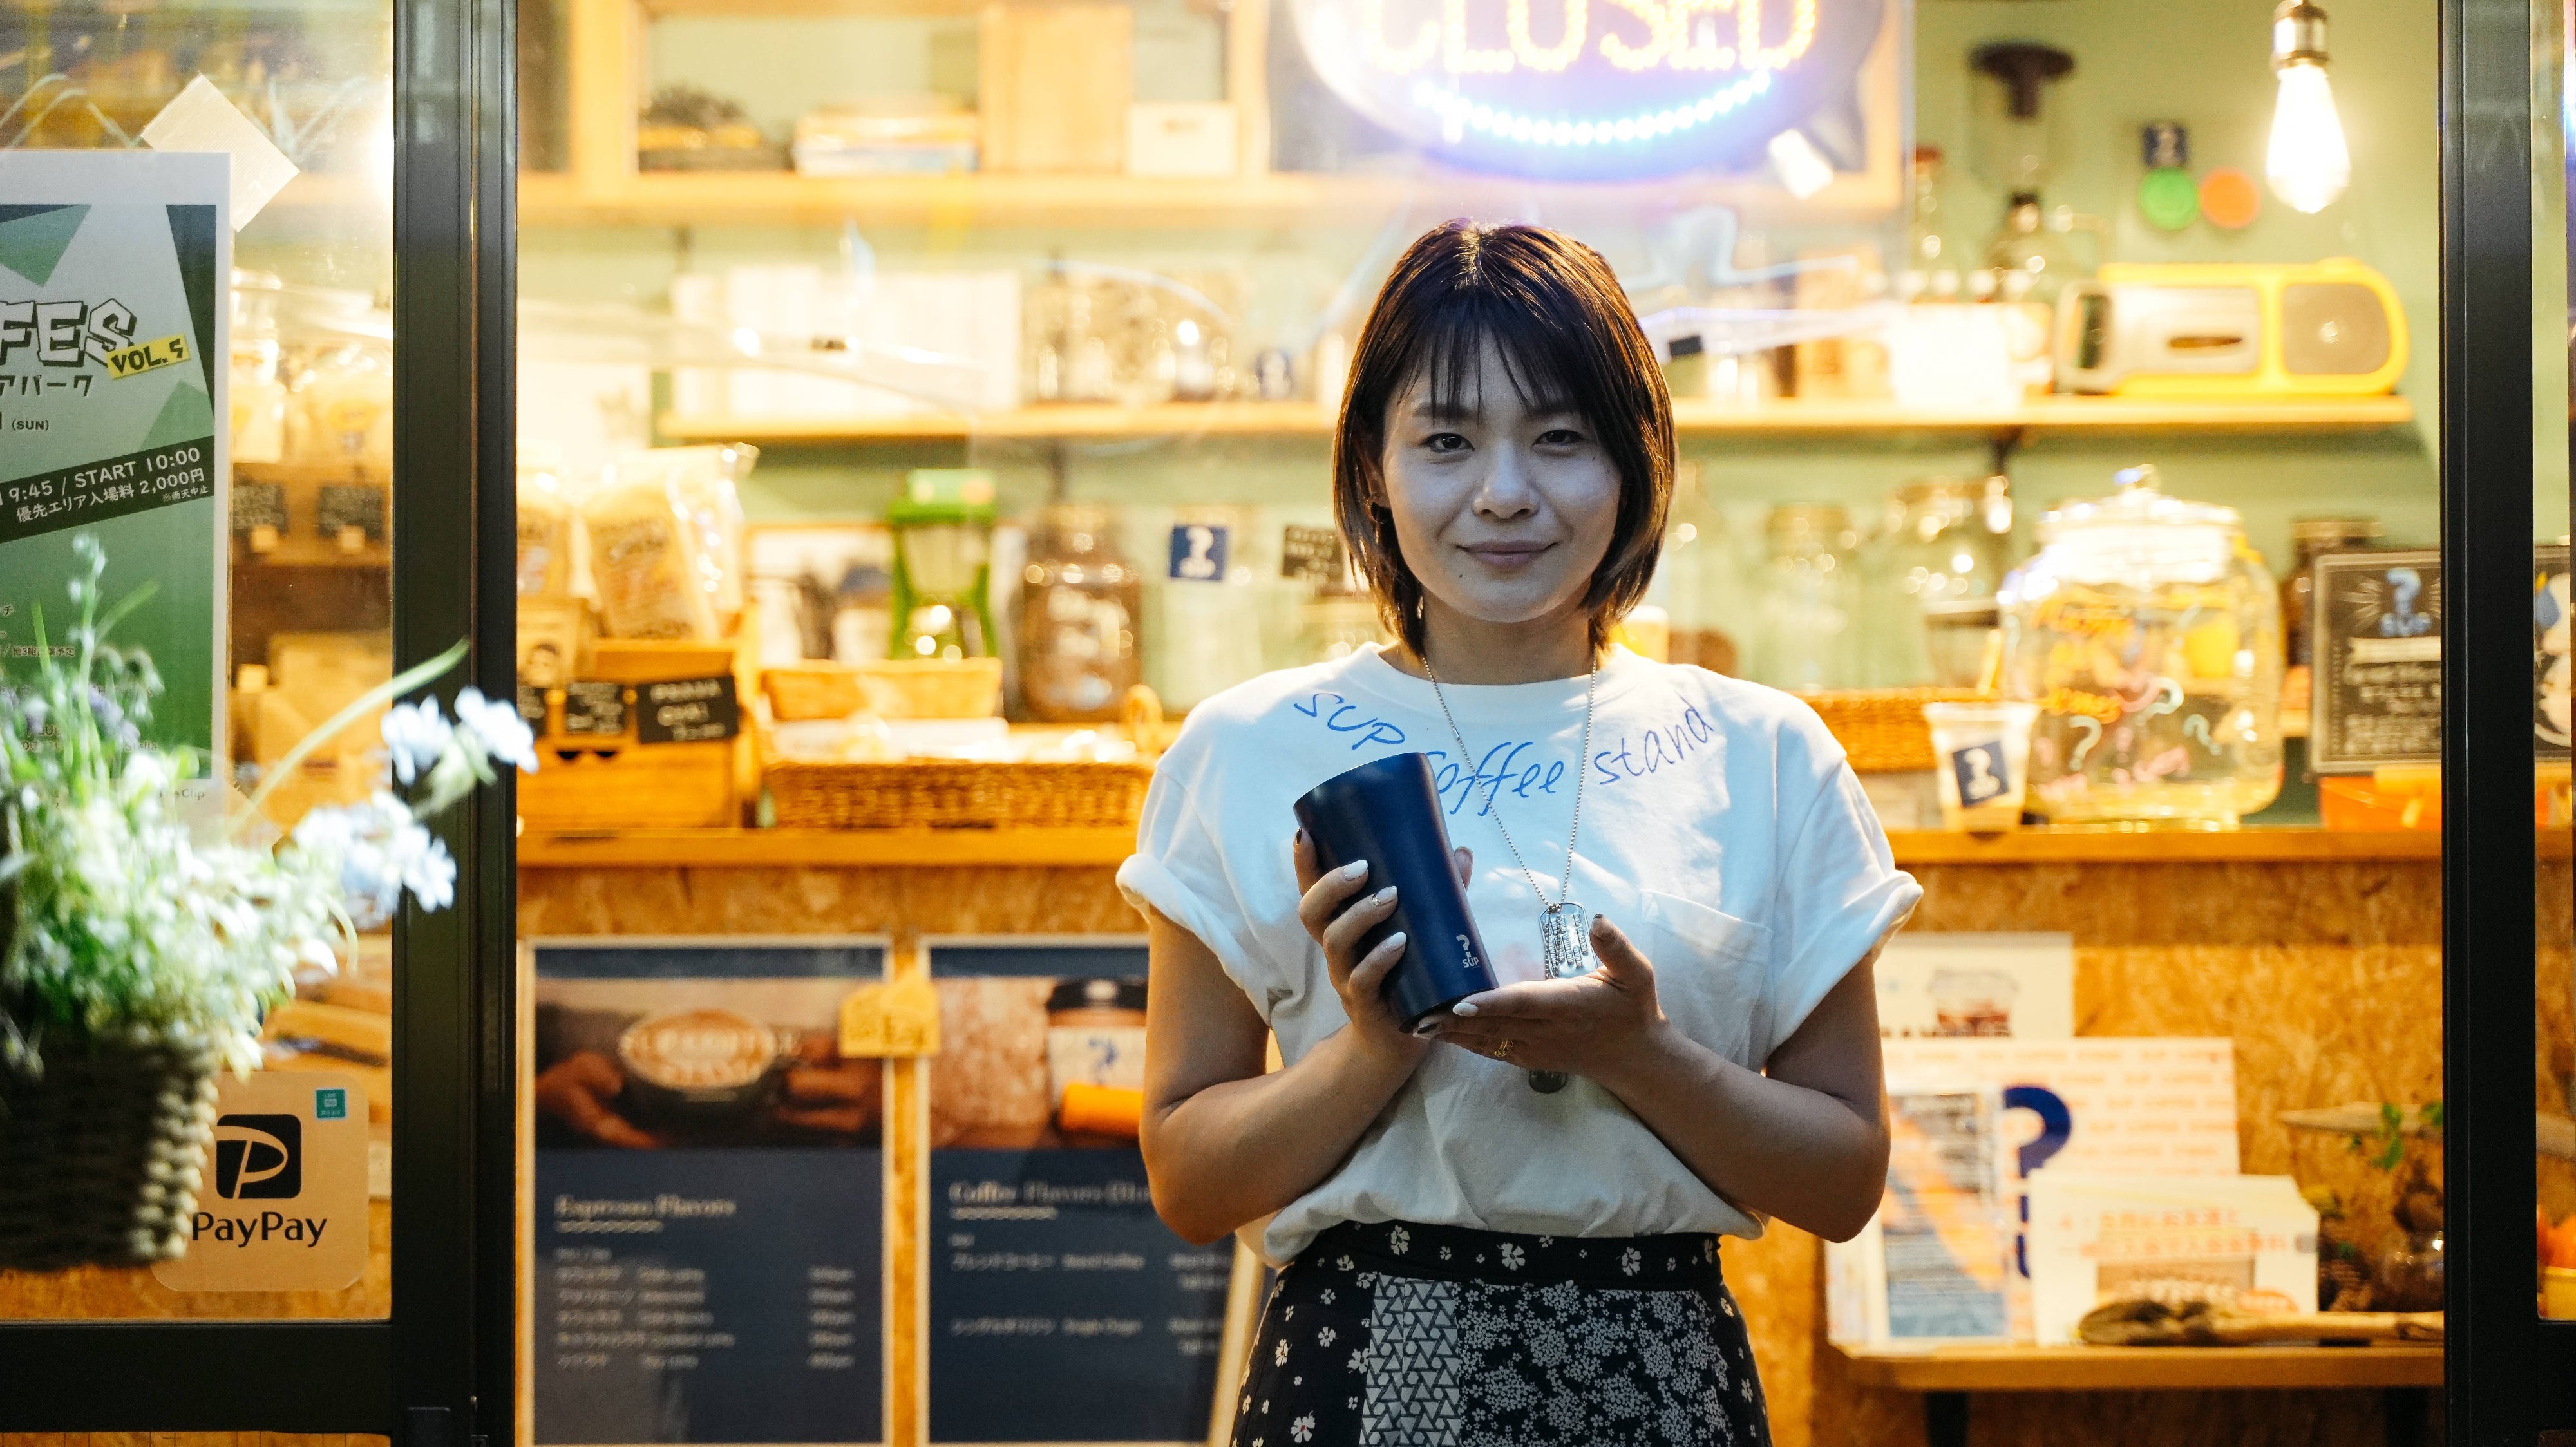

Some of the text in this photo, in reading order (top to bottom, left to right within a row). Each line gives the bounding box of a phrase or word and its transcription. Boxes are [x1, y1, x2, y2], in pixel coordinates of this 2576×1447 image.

[12, 419, 49, 431] (SUN)
[8, 480, 53, 502] 9:45
[73, 460, 137, 488] START
[146, 447, 200, 473] 10:00
[16, 468, 205, 524] 優先エリア入場料 2,000円
[1462, 956, 1479, 969] SUP
[191, 1211, 328, 1248] PayPay
